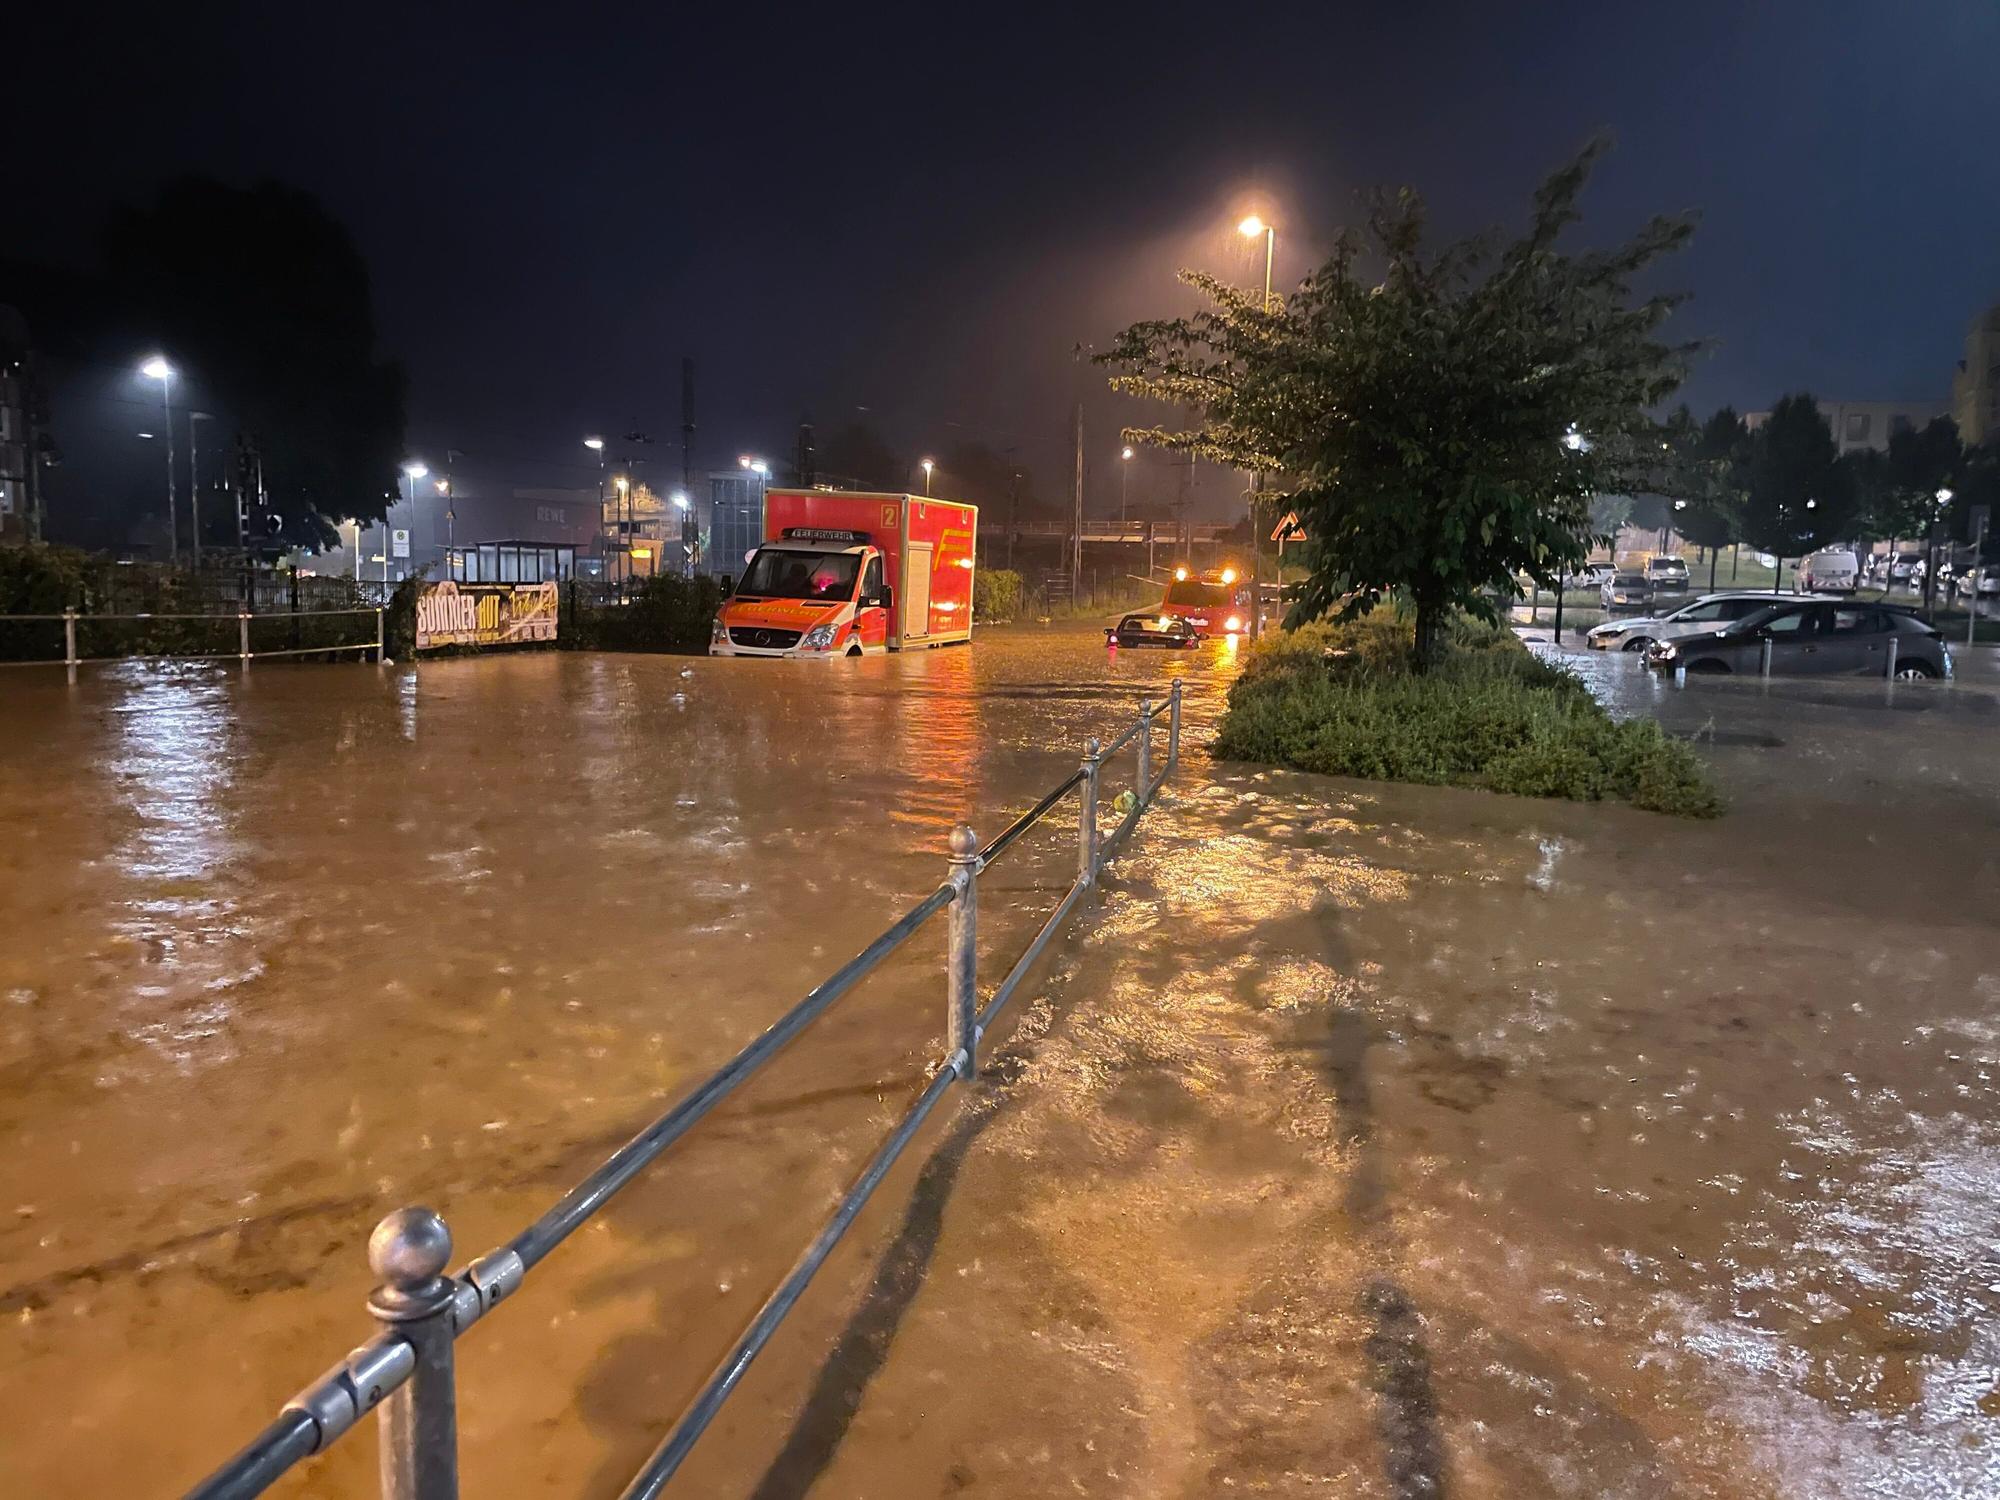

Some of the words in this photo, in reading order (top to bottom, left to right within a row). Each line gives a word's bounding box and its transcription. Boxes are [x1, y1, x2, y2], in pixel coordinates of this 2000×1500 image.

[537, 506, 565, 523] REWE
[885, 508, 895, 526] 2
[794, 529, 851, 541] FEUERWEHR
[417, 595, 476, 632] SOMMER
